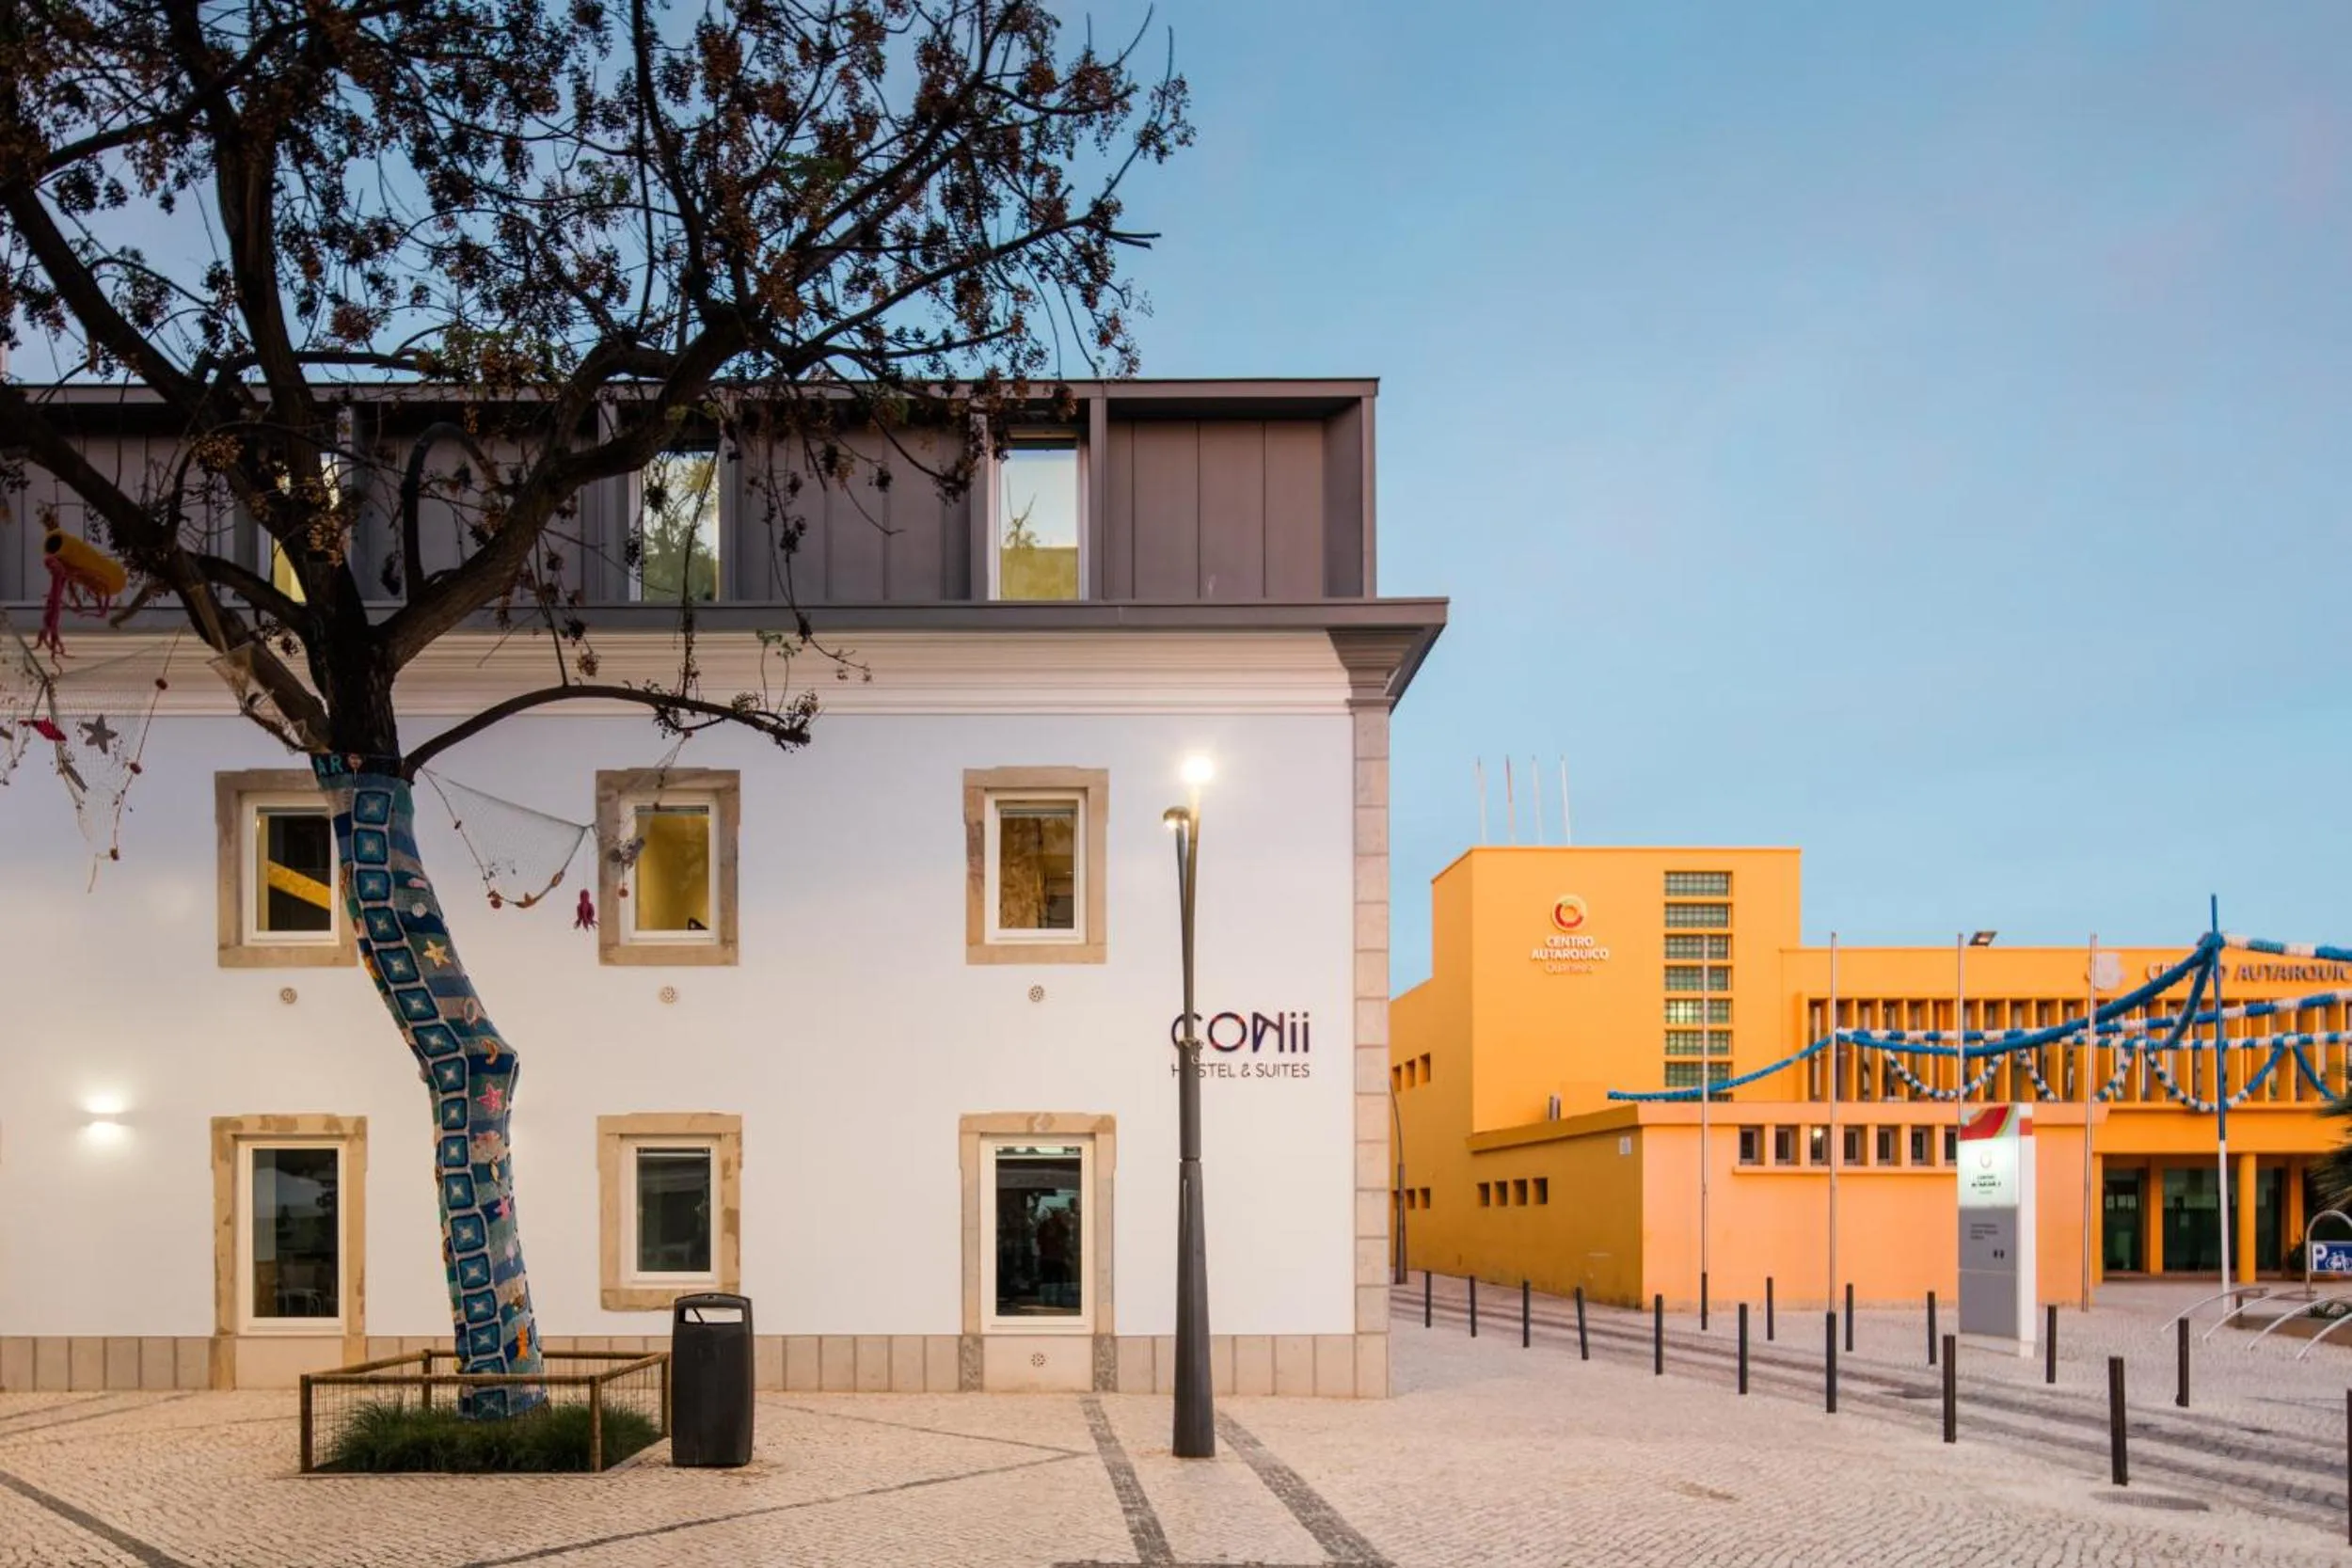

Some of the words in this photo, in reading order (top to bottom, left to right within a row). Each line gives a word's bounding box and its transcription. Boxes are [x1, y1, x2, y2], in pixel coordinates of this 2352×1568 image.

[1547, 936, 1595, 947] CENTRO
[1170, 1063, 1235, 1078] HSTEL
[1256, 1063, 1310, 1078] SUITES
[2312, 1243, 2328, 1272] P
